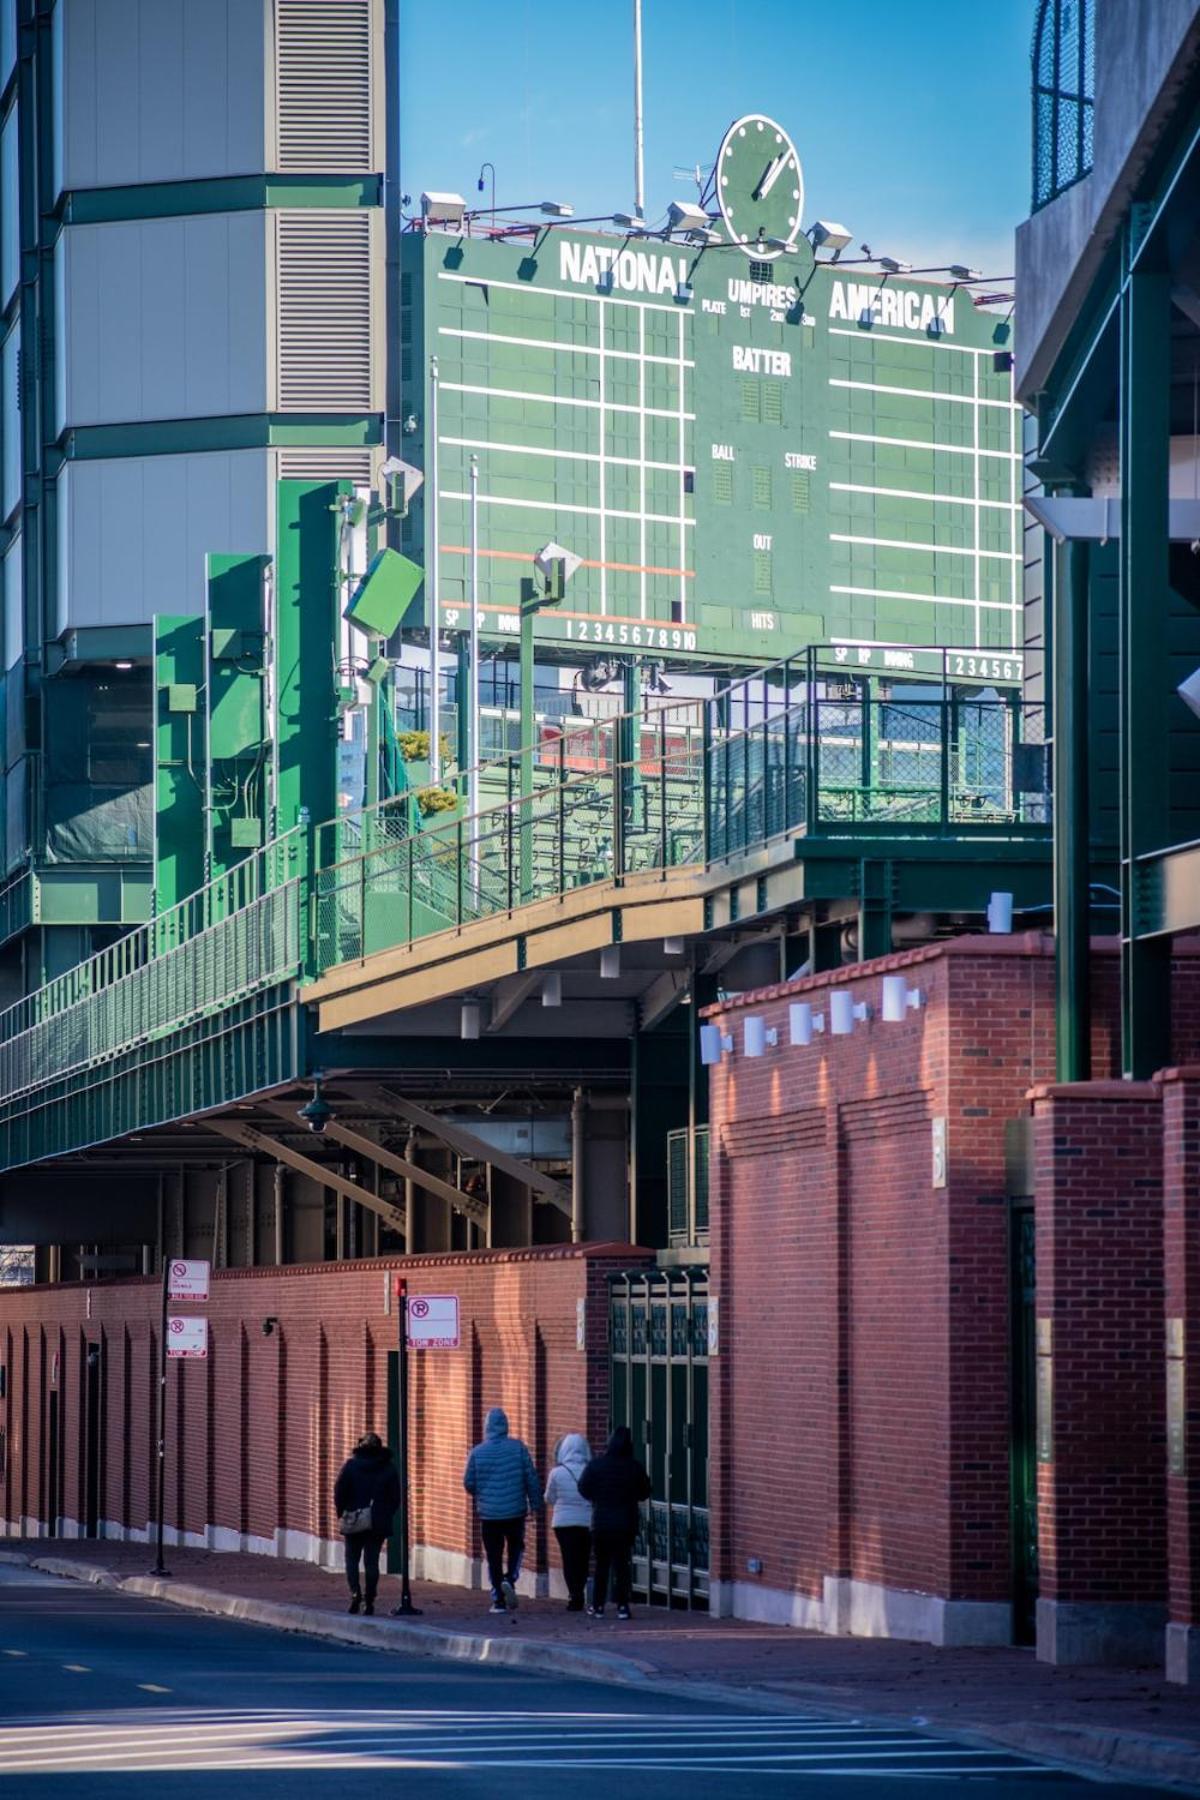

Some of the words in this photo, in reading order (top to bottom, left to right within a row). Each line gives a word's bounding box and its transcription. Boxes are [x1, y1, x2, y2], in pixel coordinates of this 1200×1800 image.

[559, 241, 694, 299] NATIONAL
[701, 298, 727, 315] PLATE
[728, 279, 796, 309] UMPIRES
[829, 281, 955, 334] AMERICAN
[733, 345, 792, 376] BATTER
[712, 444, 735, 461] BALL
[785, 452, 817, 470] STRIKE
[753, 534, 772, 550] OUT
[445, 609, 459, 626] SP
[566, 620, 572, 639] 1
[579, 621, 588, 640] 2
[593, 623, 603, 641] 3
[605, 624, 614, 642] 4
[619, 625, 628, 643] 5
[632, 626, 641, 645] 6
[646, 627, 654, 646] 7
[659, 629, 668, 647] 8
[672, 630, 681, 648] 9
[684, 631, 696, 650] 10
[751, 612, 774, 630] HITS
[835, 648, 848, 662] SP
[858, 648, 871, 665] RP
[956, 657, 964, 675] 2
[967, 658, 976, 676] 3
[979, 659, 988, 677] 4
[992, 660, 1000, 678] 5
[1003, 661, 1012, 679] 6
